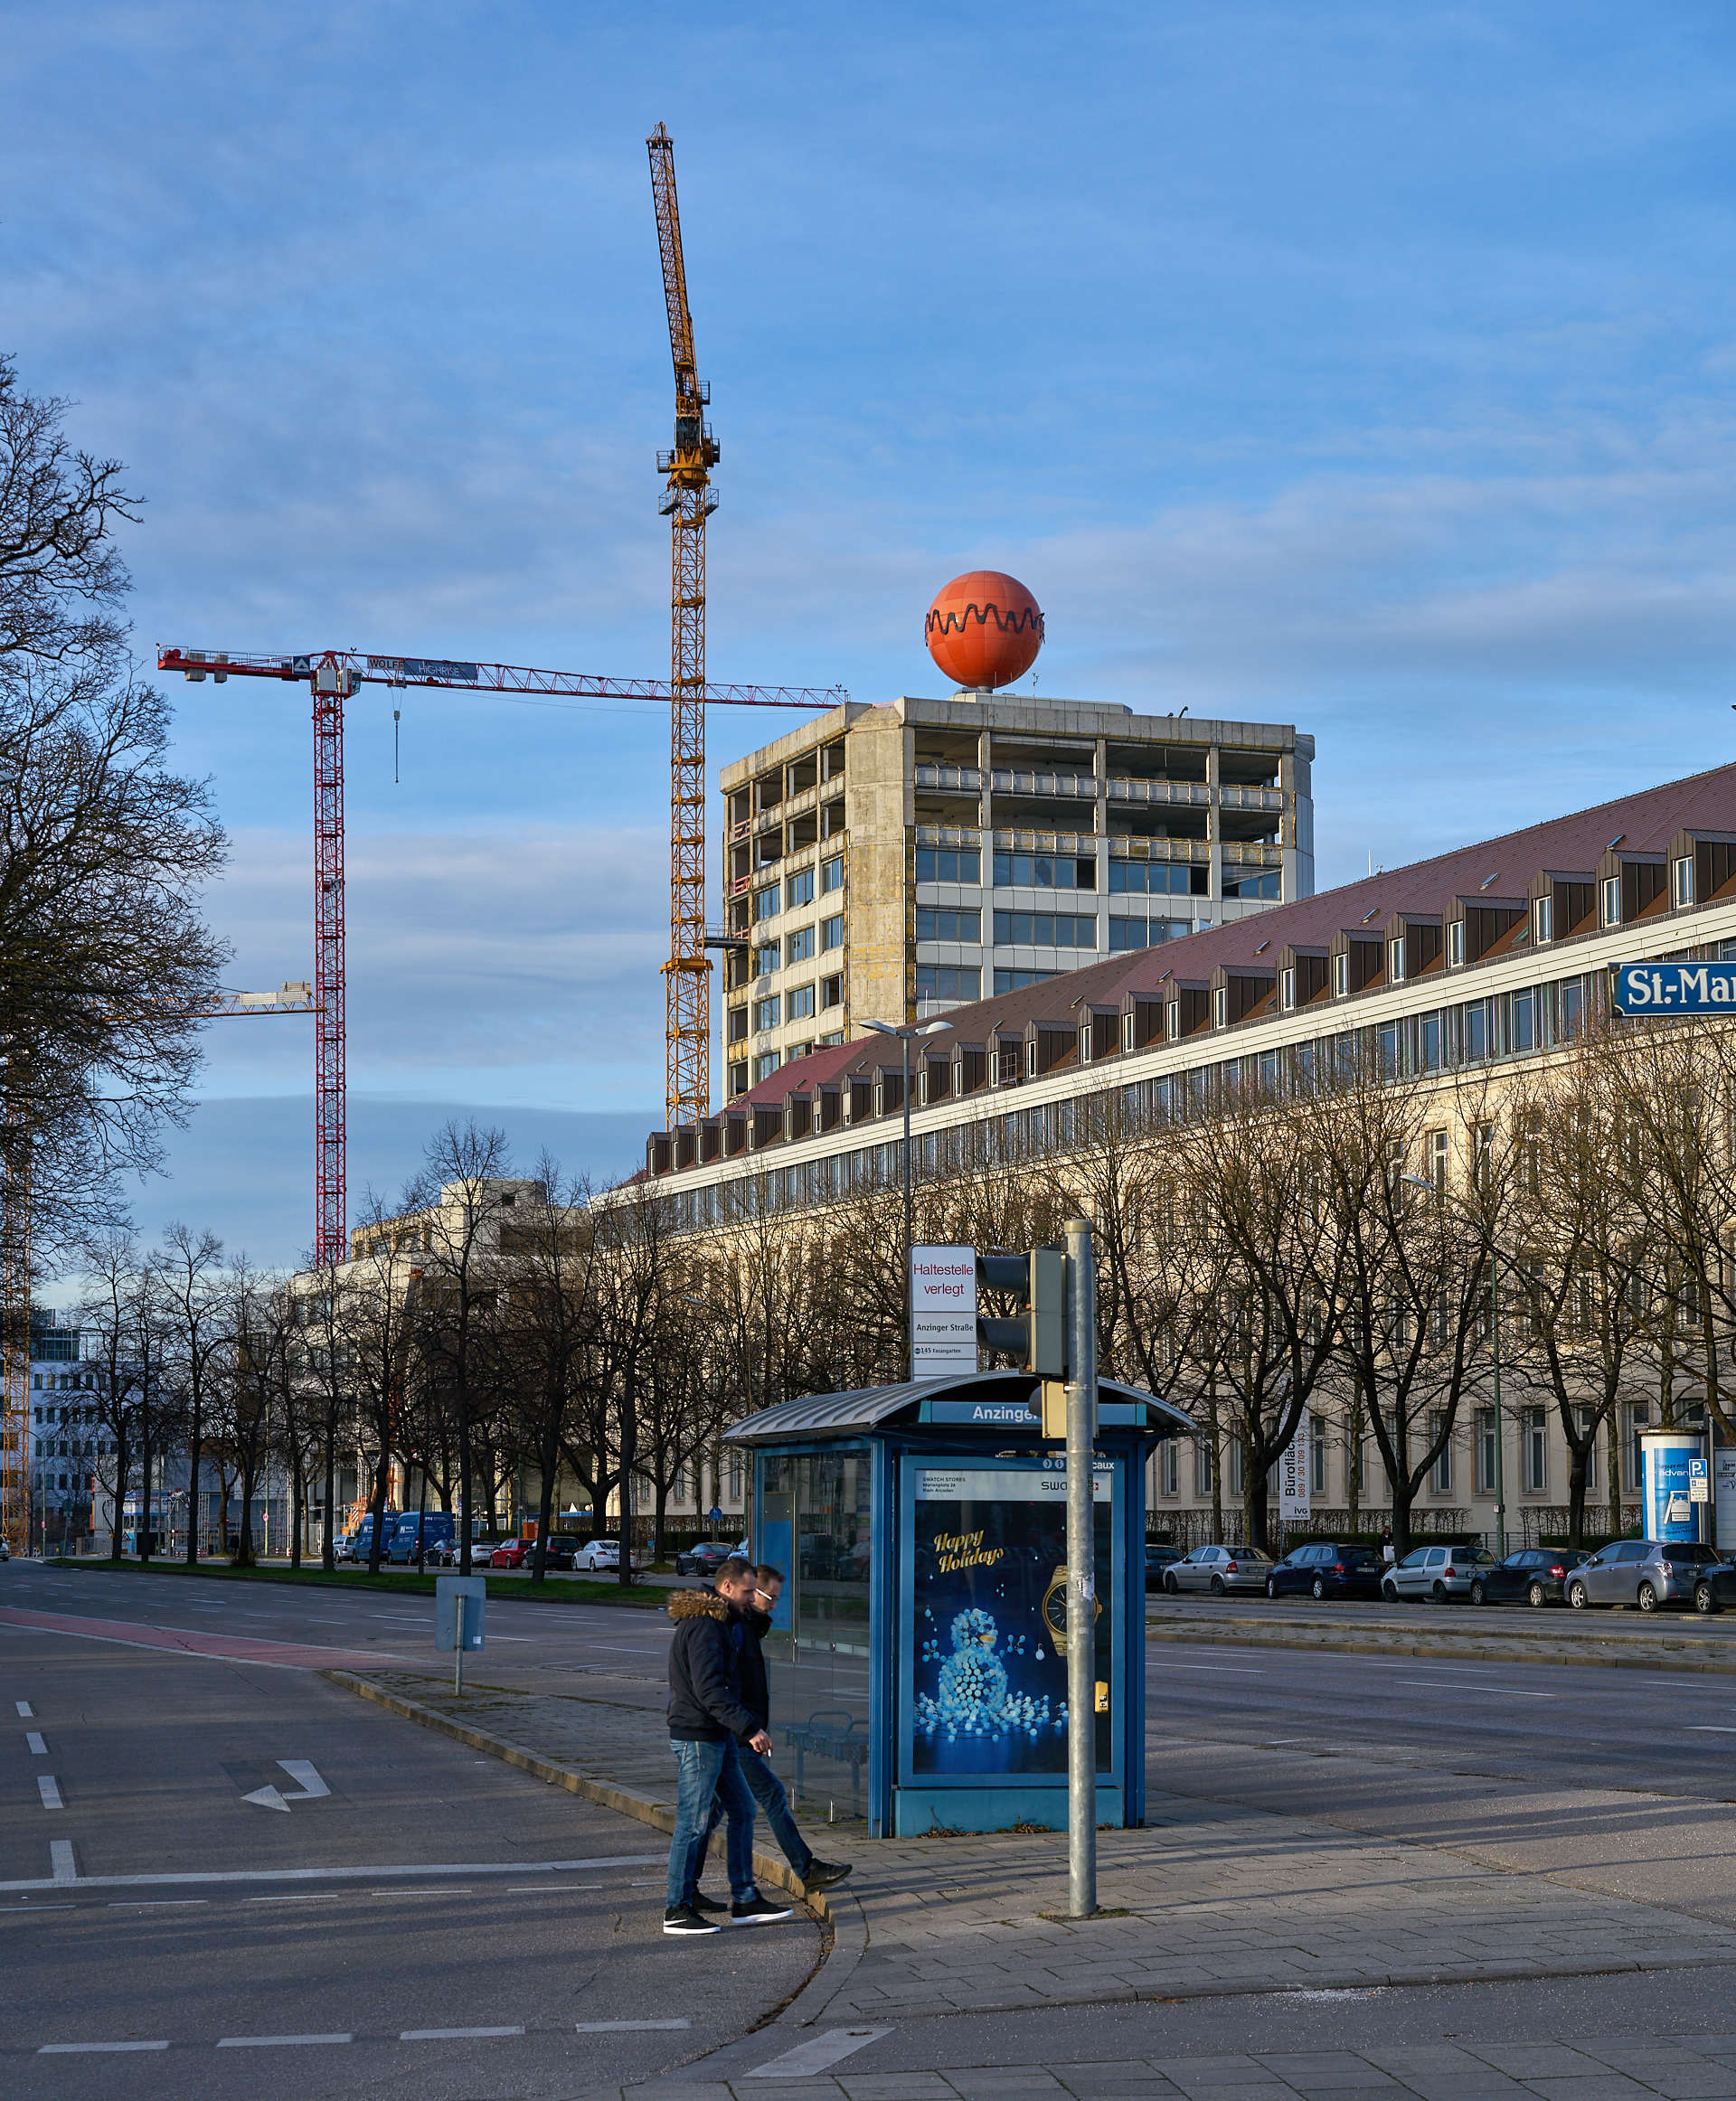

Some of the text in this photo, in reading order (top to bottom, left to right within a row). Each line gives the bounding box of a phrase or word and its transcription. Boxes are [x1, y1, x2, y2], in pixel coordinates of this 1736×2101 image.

[418, 661, 459, 676] HIGHRISE
[913, 1263, 974, 1276] Haltestelle
[923, 1282, 965, 1297] verlegt
[916, 1323, 974, 1333] Anzinger Straße
[1297, 1449, 1306, 1465] 709
[1297, 1466, 1306, 1476] 30
[1297, 1483, 1306, 1498] 089
[933, 1530, 985, 1553] Happy
[939, 1547, 1004, 1573] Holidays
